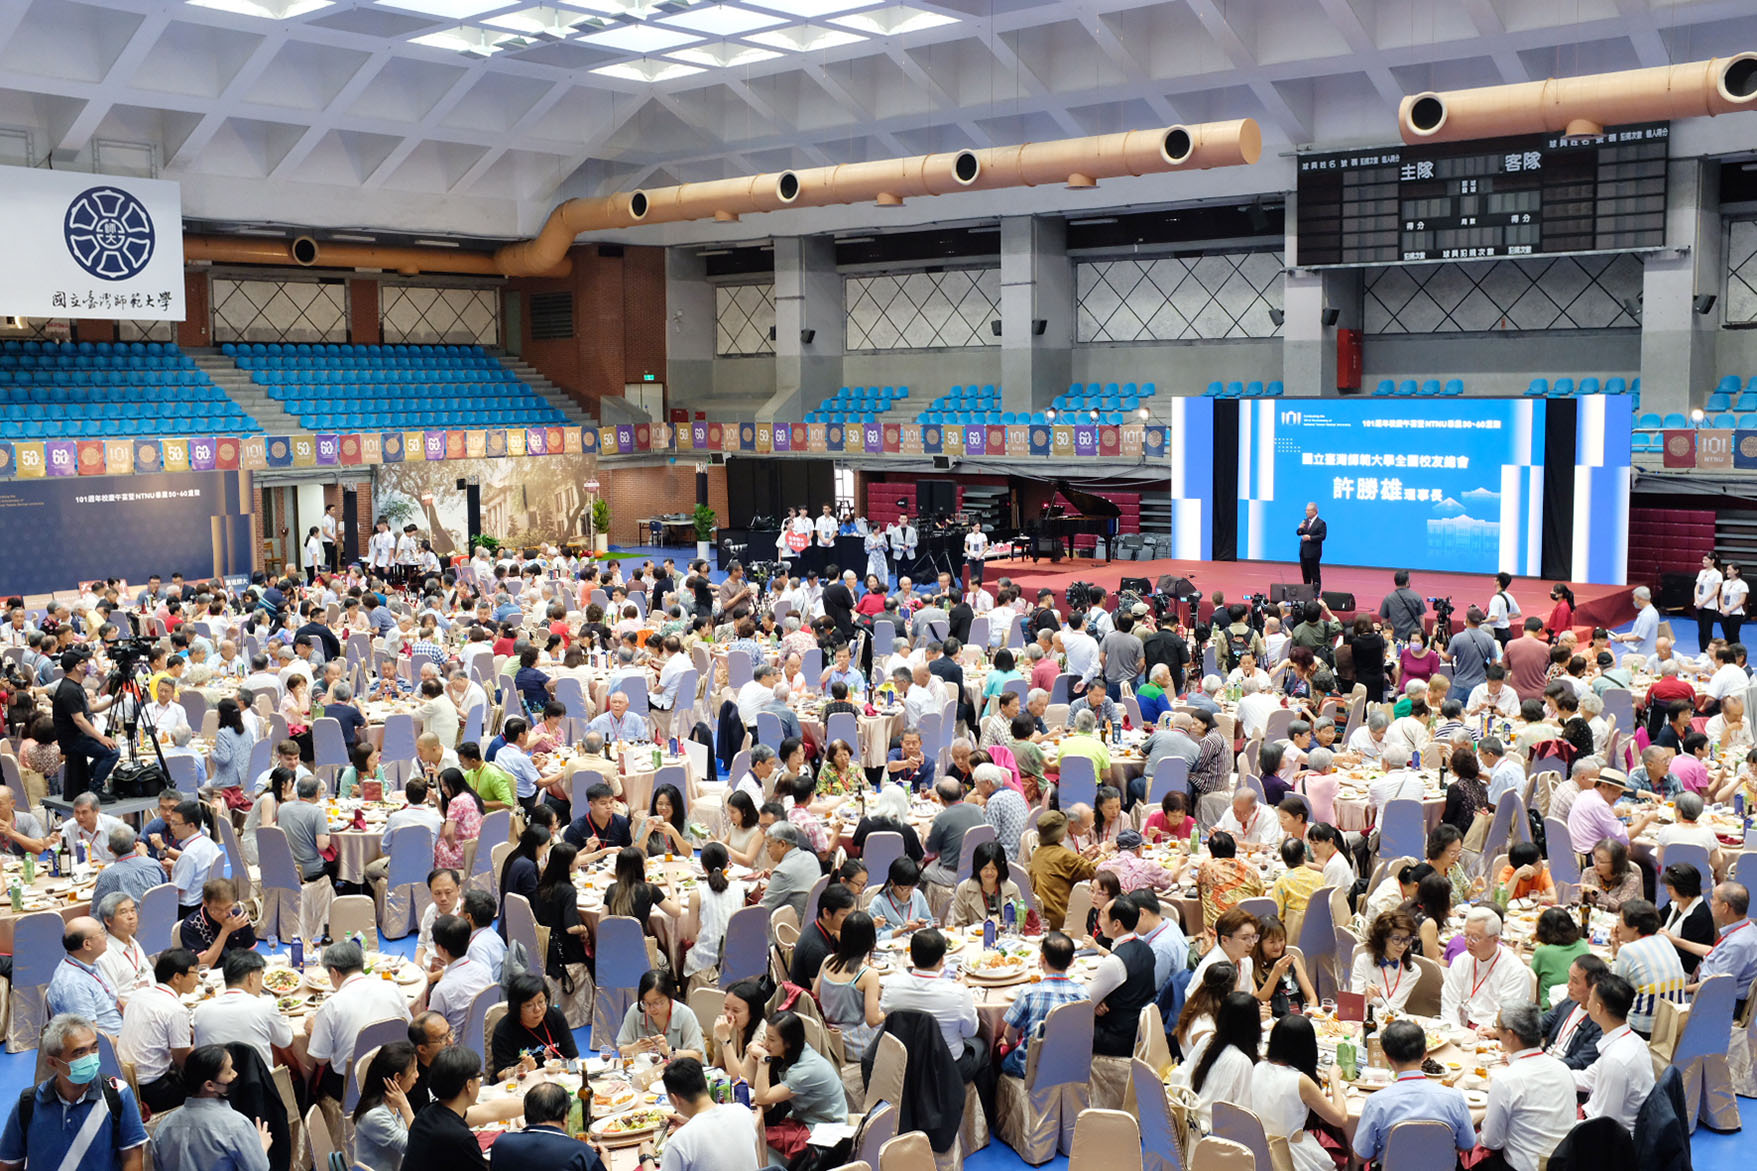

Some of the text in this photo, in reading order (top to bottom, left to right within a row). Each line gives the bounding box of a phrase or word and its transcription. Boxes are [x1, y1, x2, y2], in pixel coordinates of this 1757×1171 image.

[1400, 161, 1434, 180] 主隊
[1505, 151, 1541, 172] 客隊
[1406, 221, 1424, 230] 得分
[1511, 214, 1531, 223] 得分
[105, 222, 117, 244] 師大
[52, 290, 172, 311] 國立臺灣師範大學
[1703, 437, 1726, 454] 101
[1333, 476, 1443, 501] 許勝雄 理事長
